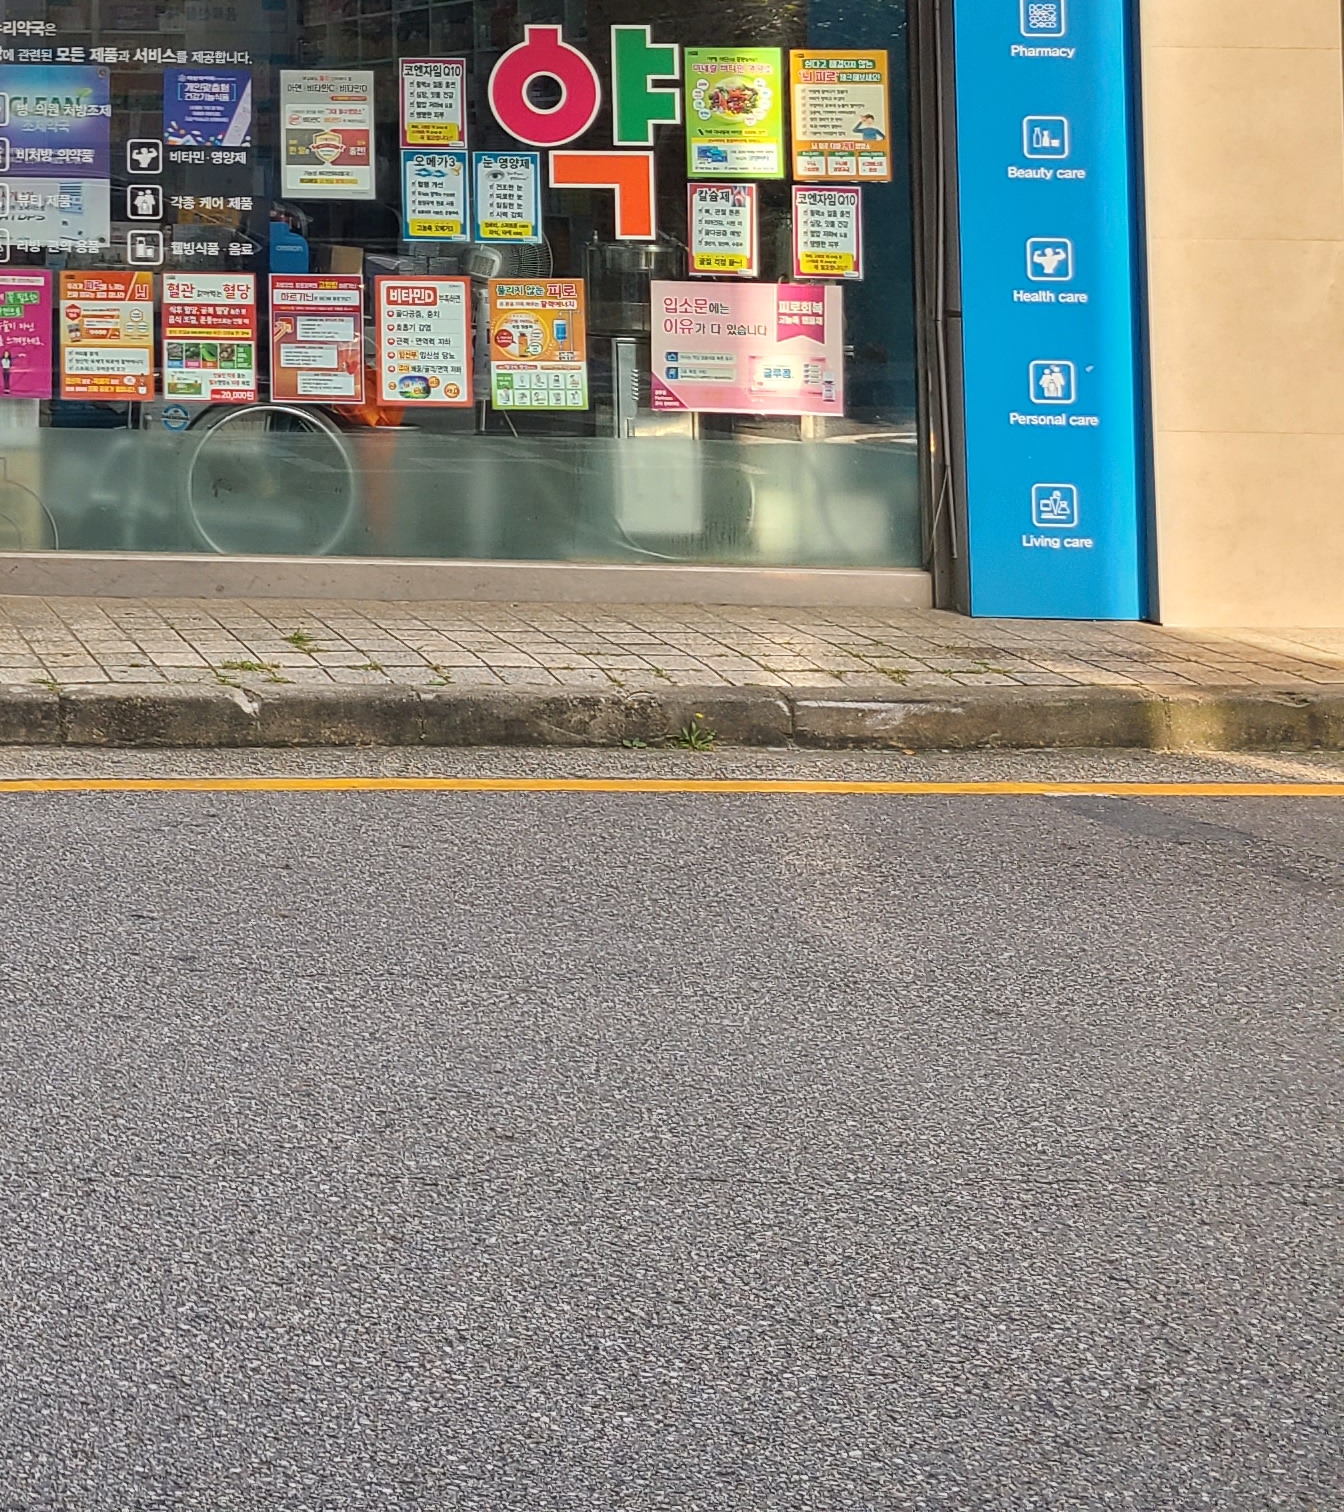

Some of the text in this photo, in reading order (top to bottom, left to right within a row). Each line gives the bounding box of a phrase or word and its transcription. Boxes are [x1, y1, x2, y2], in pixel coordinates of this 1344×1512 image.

[17, 48, 52, 62] 관련된
[55, 47, 85, 63] 모든
[89, 48, 131, 63] 제품과
[133, 47, 188, 64] 서비스를
[191, 50, 253, 65] 제공합니다.
[1011, 45, 1075, 59] Pharmacy
[404, 64, 461, 77] 코엔자임Q10
[64, 104, 111, 118] 처방조제
[16, 148, 95, 163] 비처방 의약품
[414, 155, 456, 168] 오메가3
[483, 157, 530, 169] 눈 영양제
[1008, 167, 1086, 181] Beauty care
[47, 194, 72, 207] 제품
[171, 196, 253, 210] 각종 케어 제품
[697, 189, 730, 203] 칼슘제
[797, 193, 855, 206] 코엔자임Q10
[167, 283, 251, 300] 혈관 혈당
[390, 288, 434, 304] 비타민D
[547, 284, 577, 298] 피로
[1014, 290, 1088, 303] Health care
[663, 297, 730, 315] 입소문에는
[778, 301, 824, 315] 피로회복
[663, 318, 767, 336] 이유가 다 있습니다
[1010, 413, 1099, 426] Personal care
[1023, 535, 1093, 549] Living care
